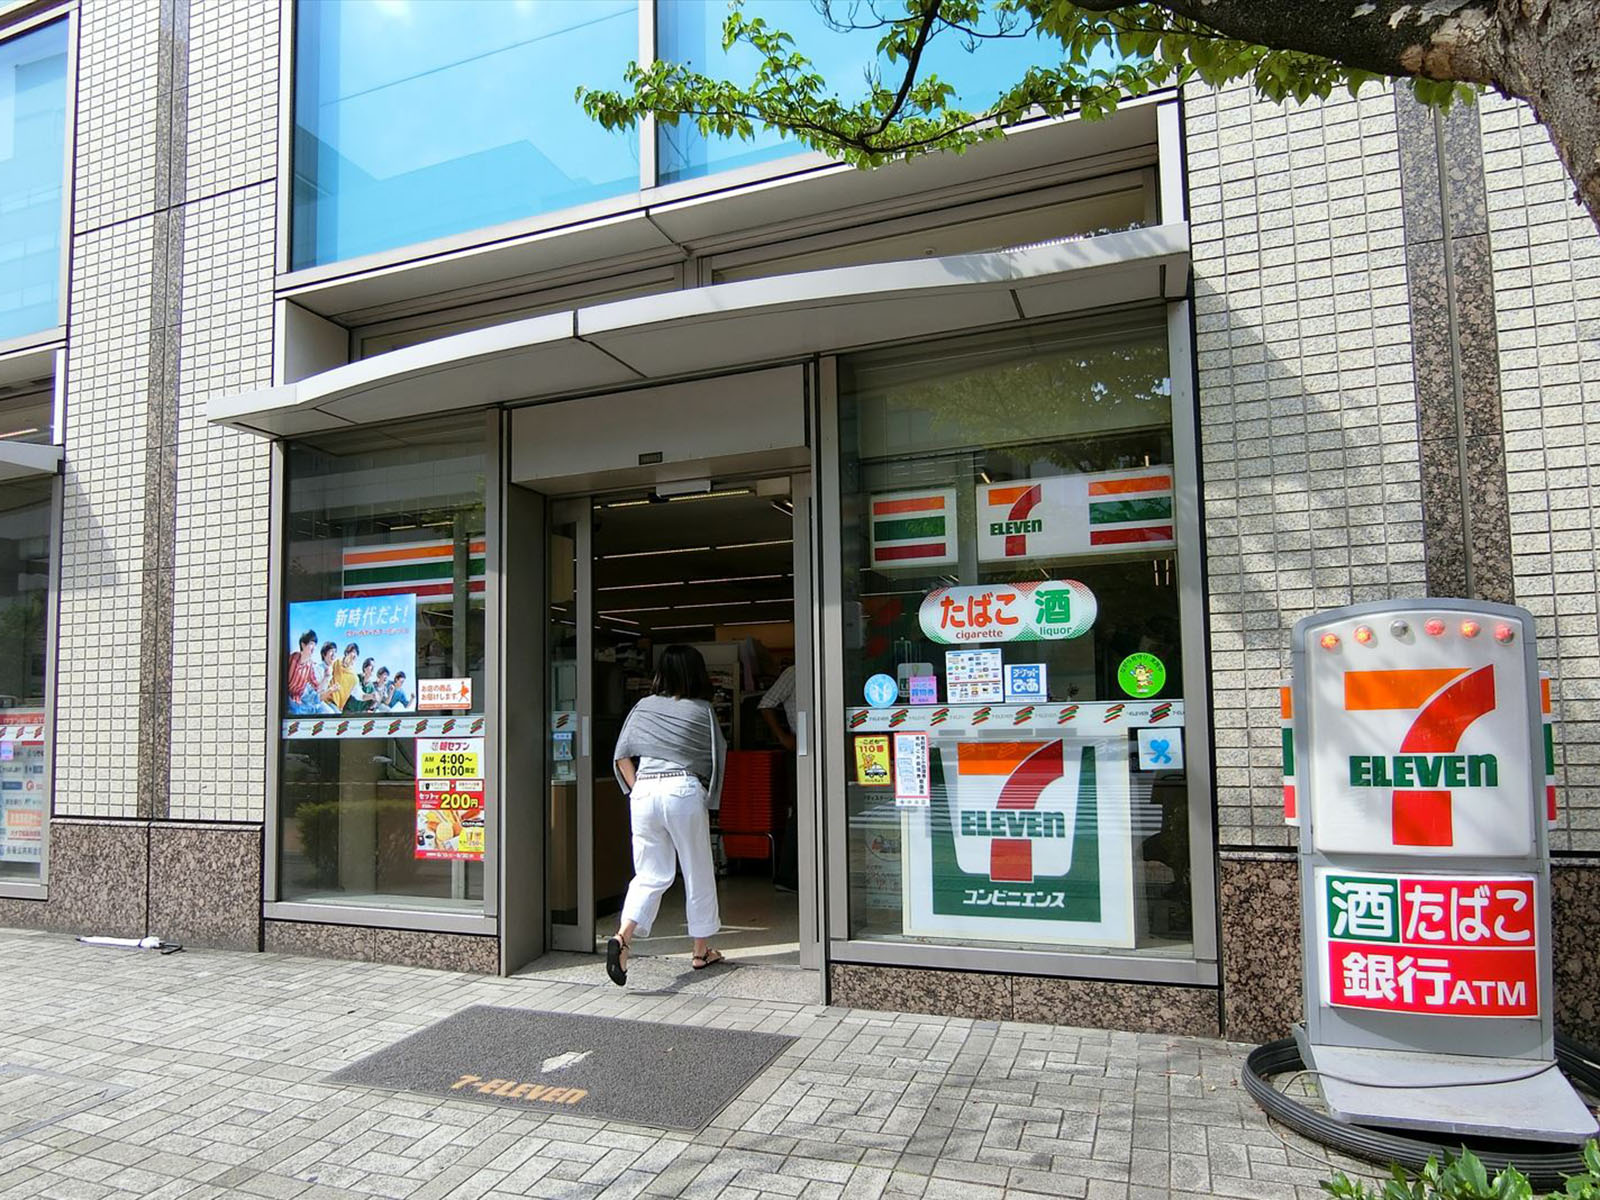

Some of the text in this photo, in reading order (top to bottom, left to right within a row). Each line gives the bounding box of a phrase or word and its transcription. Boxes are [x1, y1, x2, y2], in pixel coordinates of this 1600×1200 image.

[940, 589, 1071, 629] たばこ 酒
[955, 625, 1072, 641] cigarette liquor
[962, 889, 1066, 908] コンビニエンス
[1331, 880, 1531, 942] 酒 たばこ
